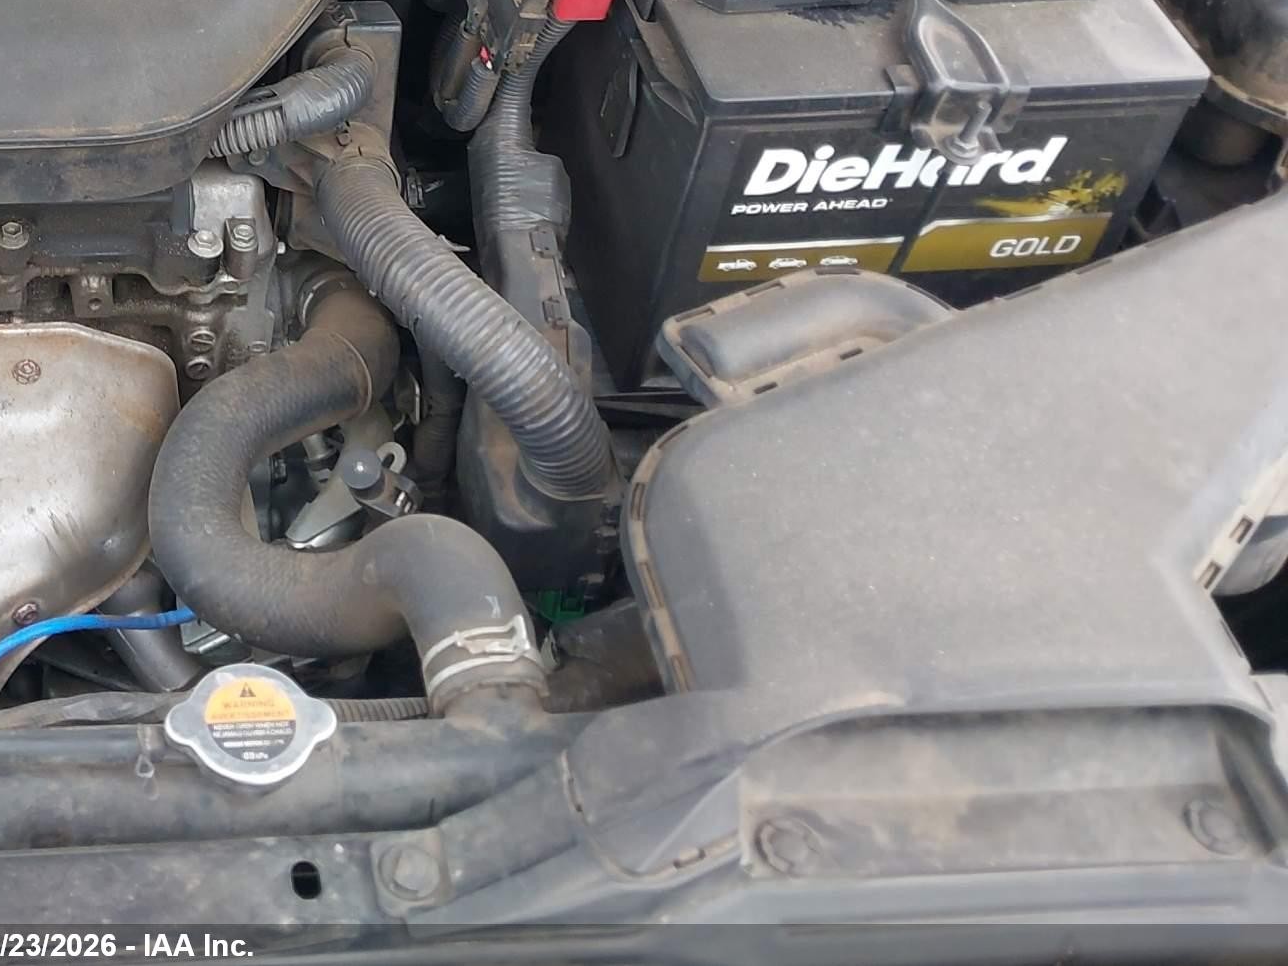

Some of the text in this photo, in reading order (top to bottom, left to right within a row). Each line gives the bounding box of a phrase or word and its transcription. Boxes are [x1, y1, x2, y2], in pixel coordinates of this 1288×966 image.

[731, 198, 888, 216] POWER AHEAD
[989, 235, 1082, 259] GOLD
